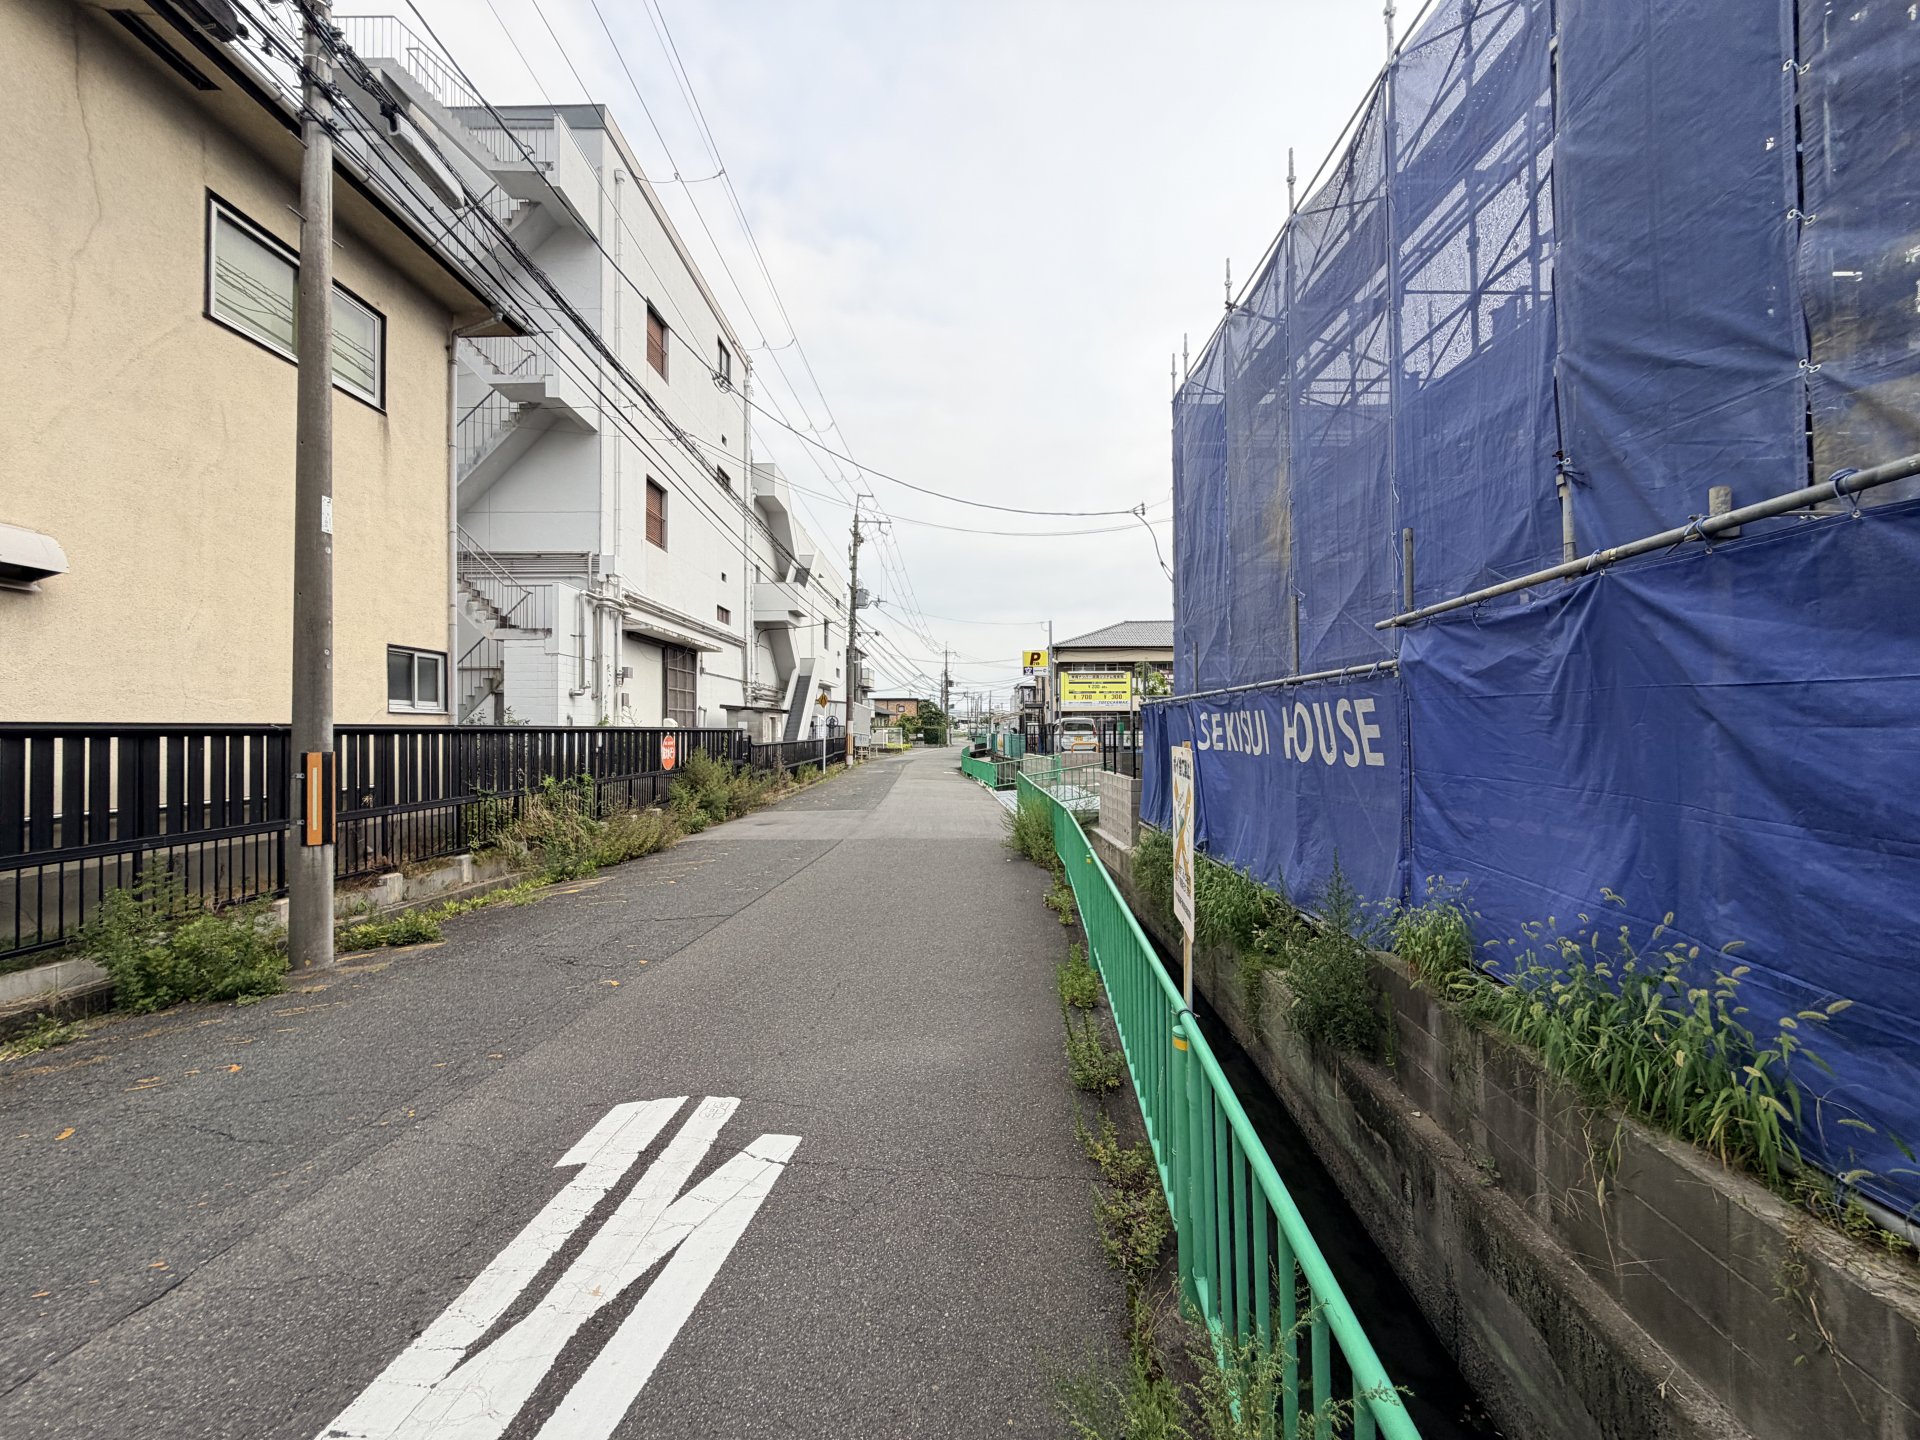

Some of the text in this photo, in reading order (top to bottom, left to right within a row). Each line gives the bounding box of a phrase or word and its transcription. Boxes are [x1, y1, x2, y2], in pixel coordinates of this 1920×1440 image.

[1030, 652, 1041, 666] P
[1197, 698, 1385, 768] SEKISUI HOUSE
